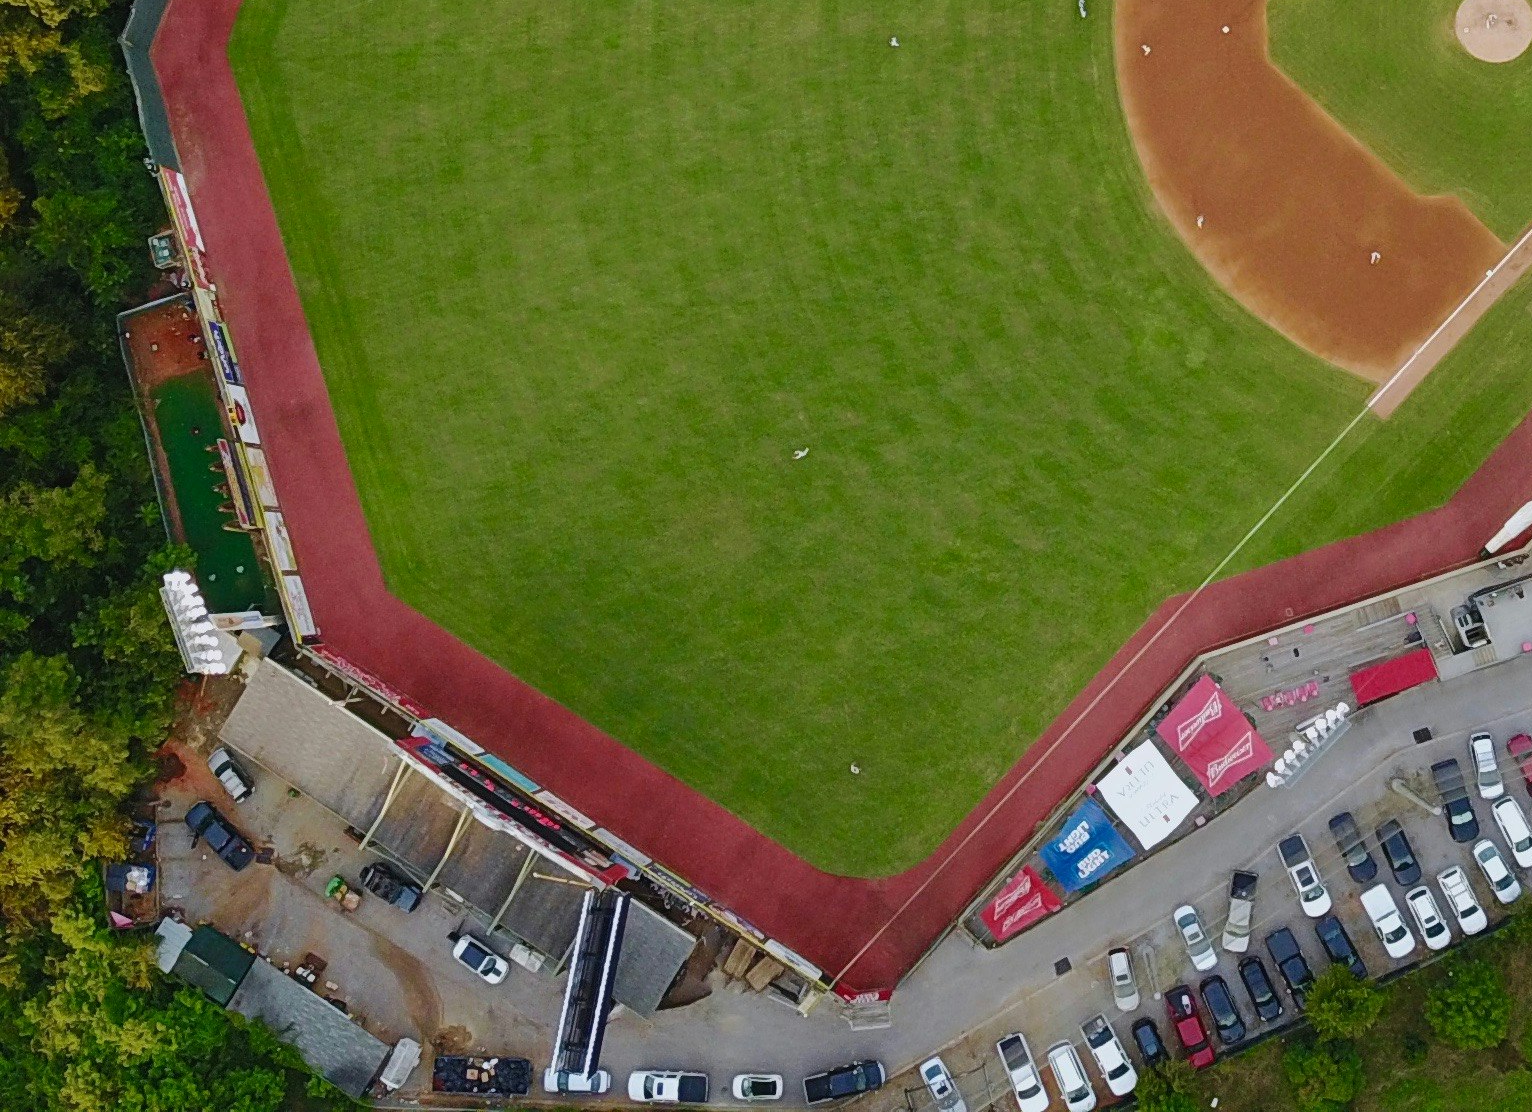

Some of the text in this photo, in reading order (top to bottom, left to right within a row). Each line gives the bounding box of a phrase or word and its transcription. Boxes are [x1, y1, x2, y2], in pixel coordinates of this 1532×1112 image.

[1180, 700, 1219, 742] Budweiser
[1210, 742, 1251, 779] Budweiser
[1059, 820, 1089, 852] LIGHT
[1066, 831, 1090, 854] BUD
[1077, 848, 1101, 870] BUD
[1078, 850, 1109, 879] LIGHT
